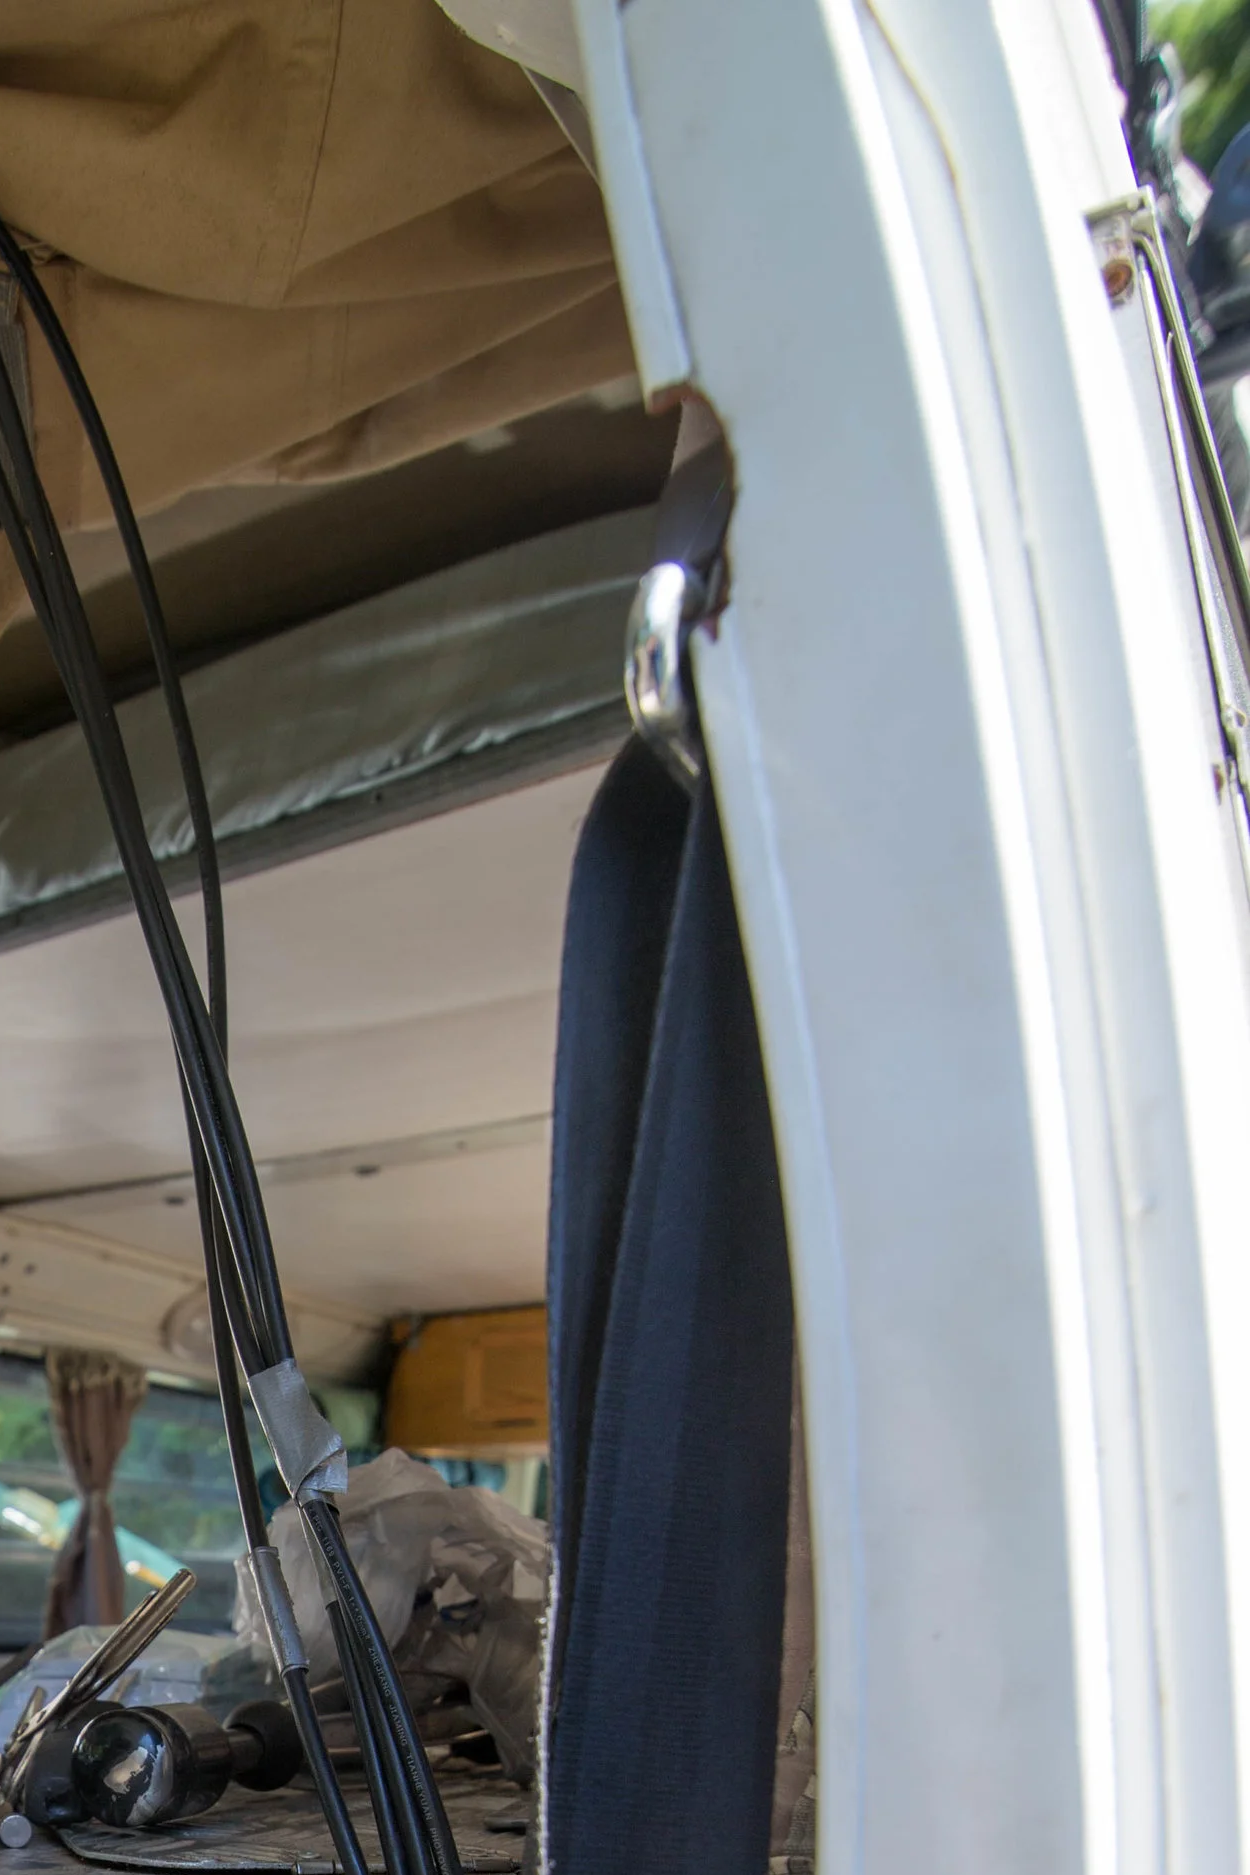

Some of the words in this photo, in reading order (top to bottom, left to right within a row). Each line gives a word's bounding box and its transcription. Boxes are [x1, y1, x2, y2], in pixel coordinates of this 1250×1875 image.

[368, 1647, 391, 1698] ZHEJIANG
[388, 1703, 409, 1747] JIAMING
[405, 1753, 433, 1821] TIANHEYUAN
